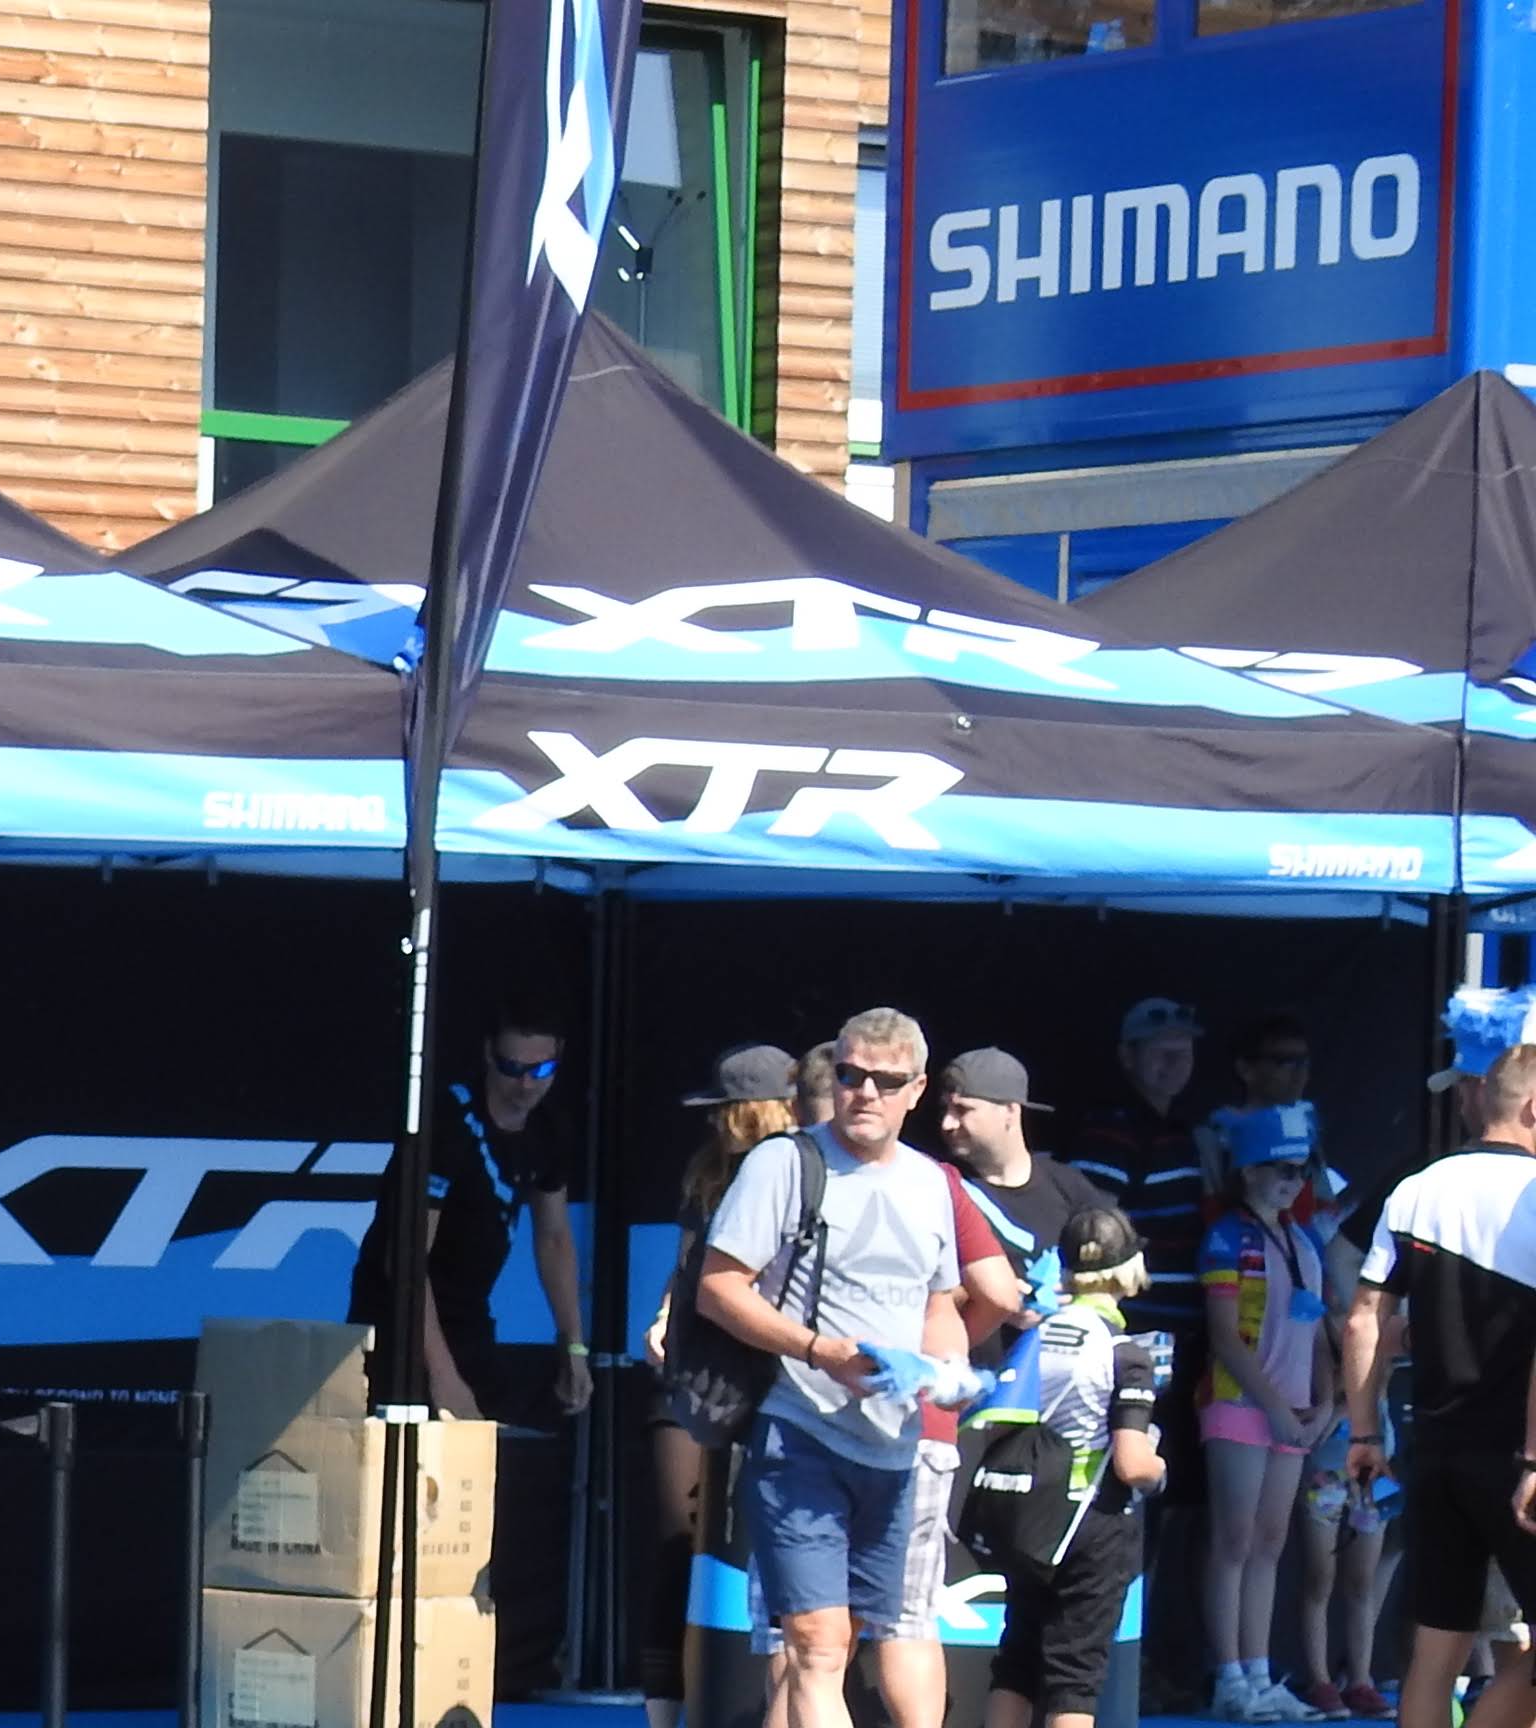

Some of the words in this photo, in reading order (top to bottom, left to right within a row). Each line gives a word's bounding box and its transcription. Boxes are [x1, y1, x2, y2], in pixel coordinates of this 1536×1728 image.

[930, 153, 1421, 311] SHIMANO
[520, 577, 1120, 691] XTR
[202, 791, 386, 831] SHIMANO
[471, 731, 965, 851] XTR
[1268, 843, 1423, 882] SHIMANO
